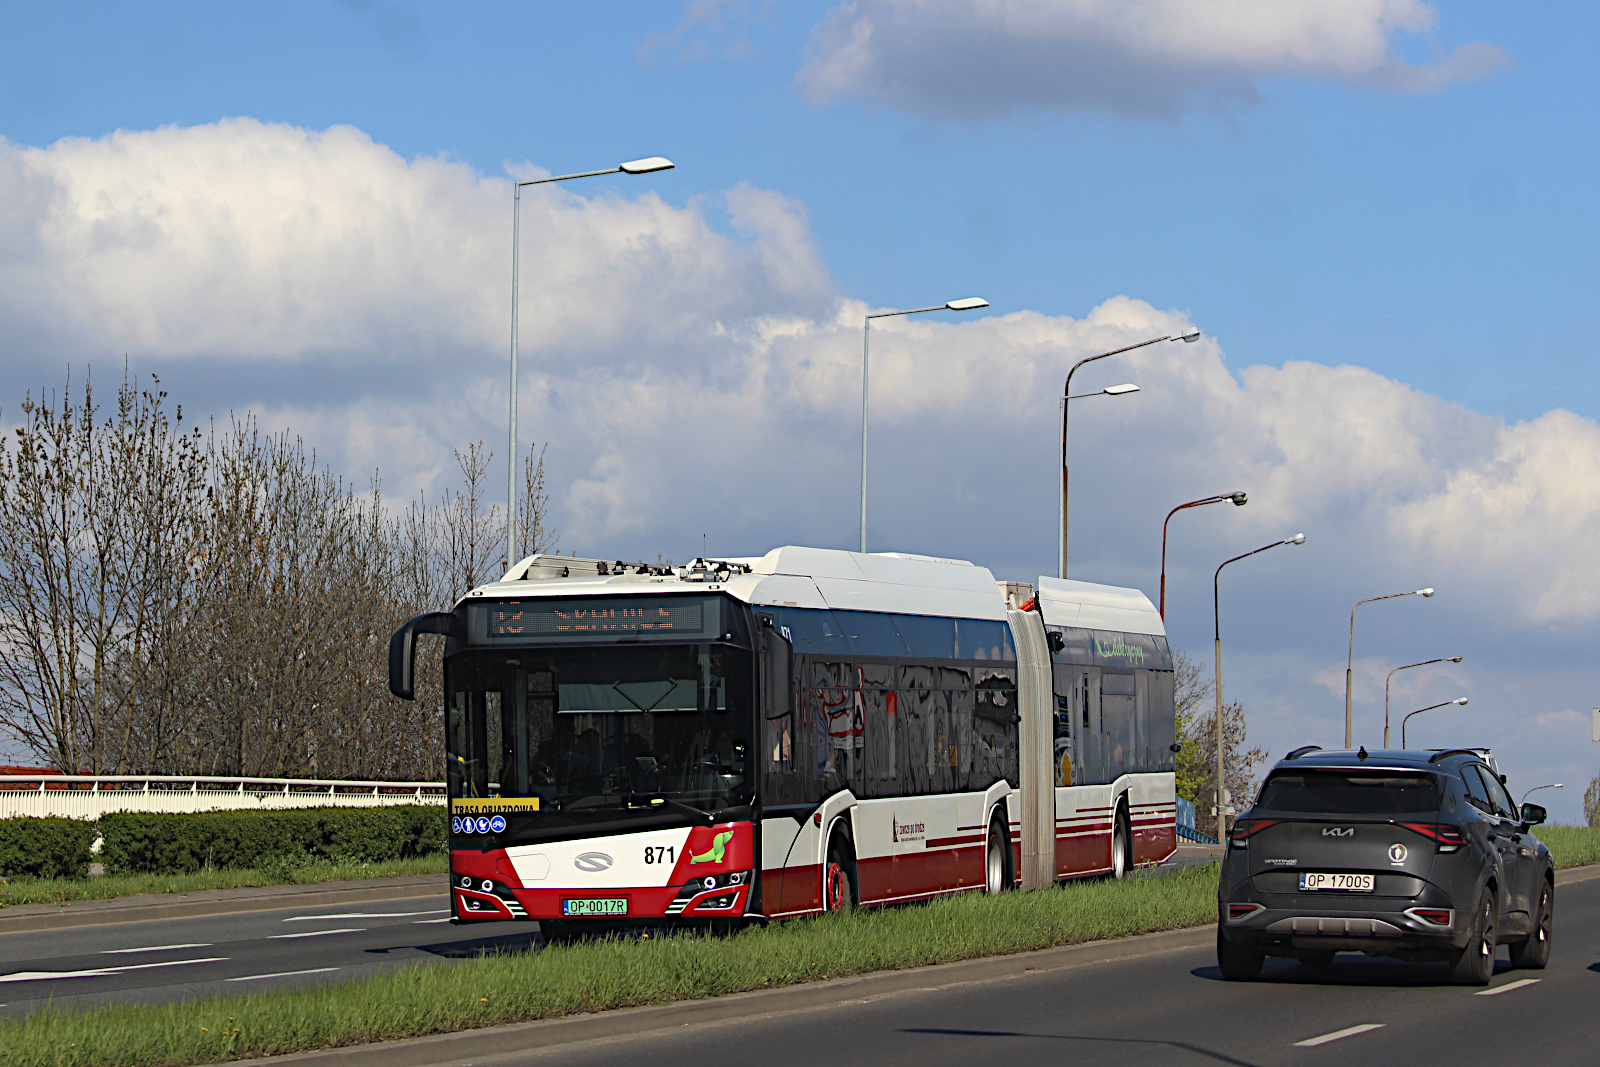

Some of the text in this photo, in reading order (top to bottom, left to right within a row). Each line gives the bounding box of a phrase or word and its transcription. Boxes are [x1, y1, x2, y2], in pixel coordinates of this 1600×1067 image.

[1322, 827, 1354, 837] KIA
[644, 846, 675, 865] 871
[1308, 874, 1371, 889] OP 1700S
[570, 900, 624, 912] OP 0017R
